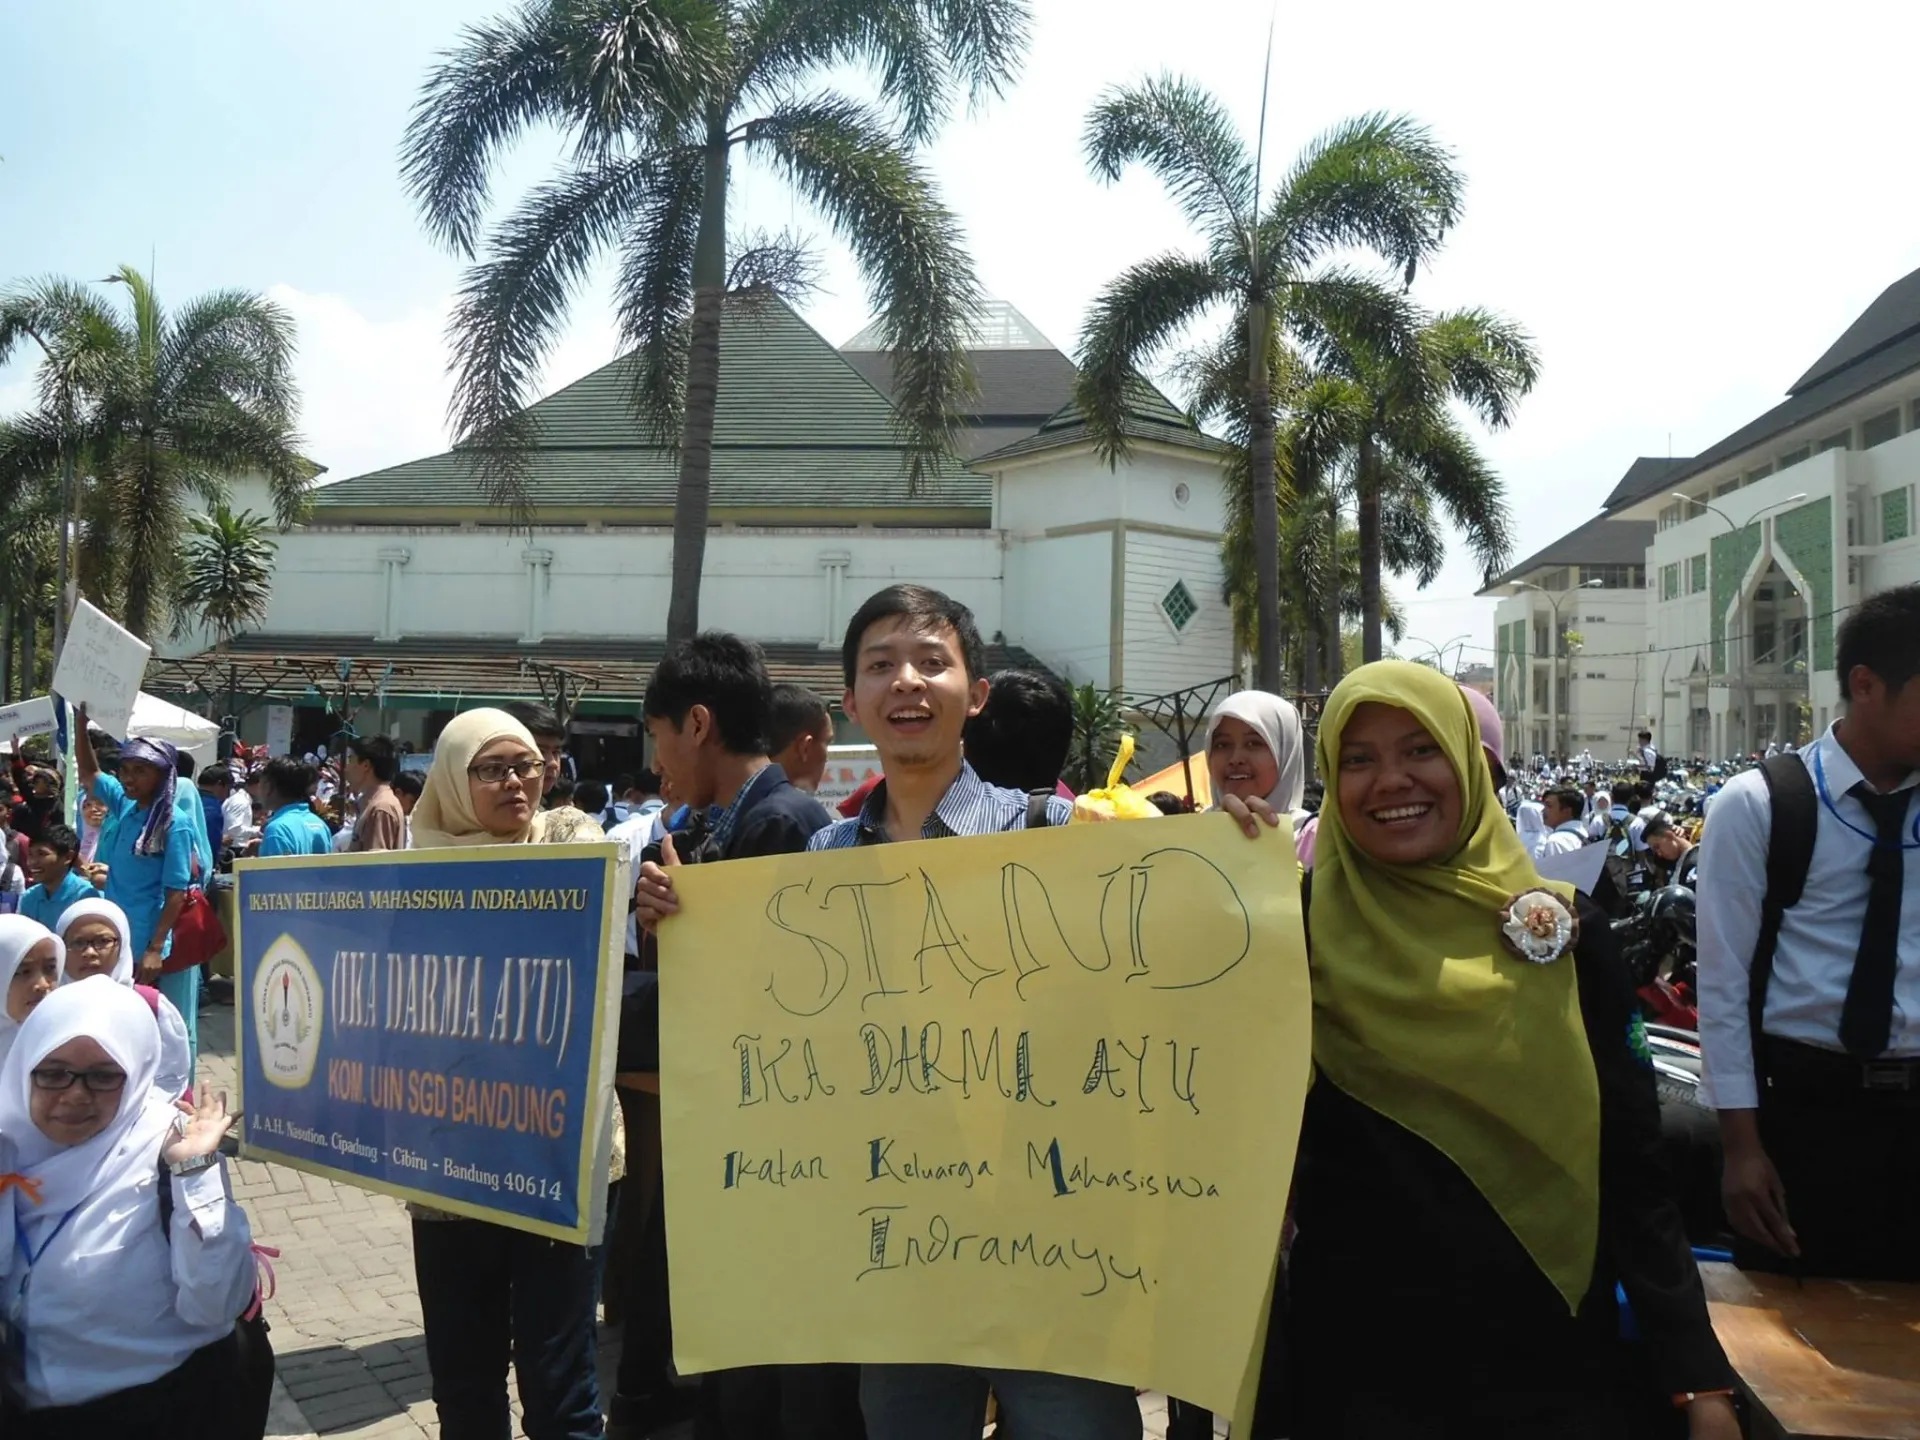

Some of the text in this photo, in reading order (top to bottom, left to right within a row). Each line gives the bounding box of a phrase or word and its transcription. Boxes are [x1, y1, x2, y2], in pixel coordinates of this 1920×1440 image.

[249, 888, 588, 911] IKATAN KELUARGA MAHASISWA INDRAMAYU
[764, 847, 1250, 1017] STAND
[384, 953, 484, 1039] DARMA
[328, 1058, 567, 1139] KOM. UIN SGD BANDUNG
[734, 1021, 1201, 1116] IKA DARMA AYU
[264, 1117, 285, 1135] A.H.
[331, 1132, 378, 1163] Cipadung
[392, 1147, 428, 1171] Cibiru
[443, 1157, 500, 1191] Bandung
[503, 1172, 563, 1202] 40614
[724, 1136, 1220, 1199] Ikatan Keluarga Mahasiswa
